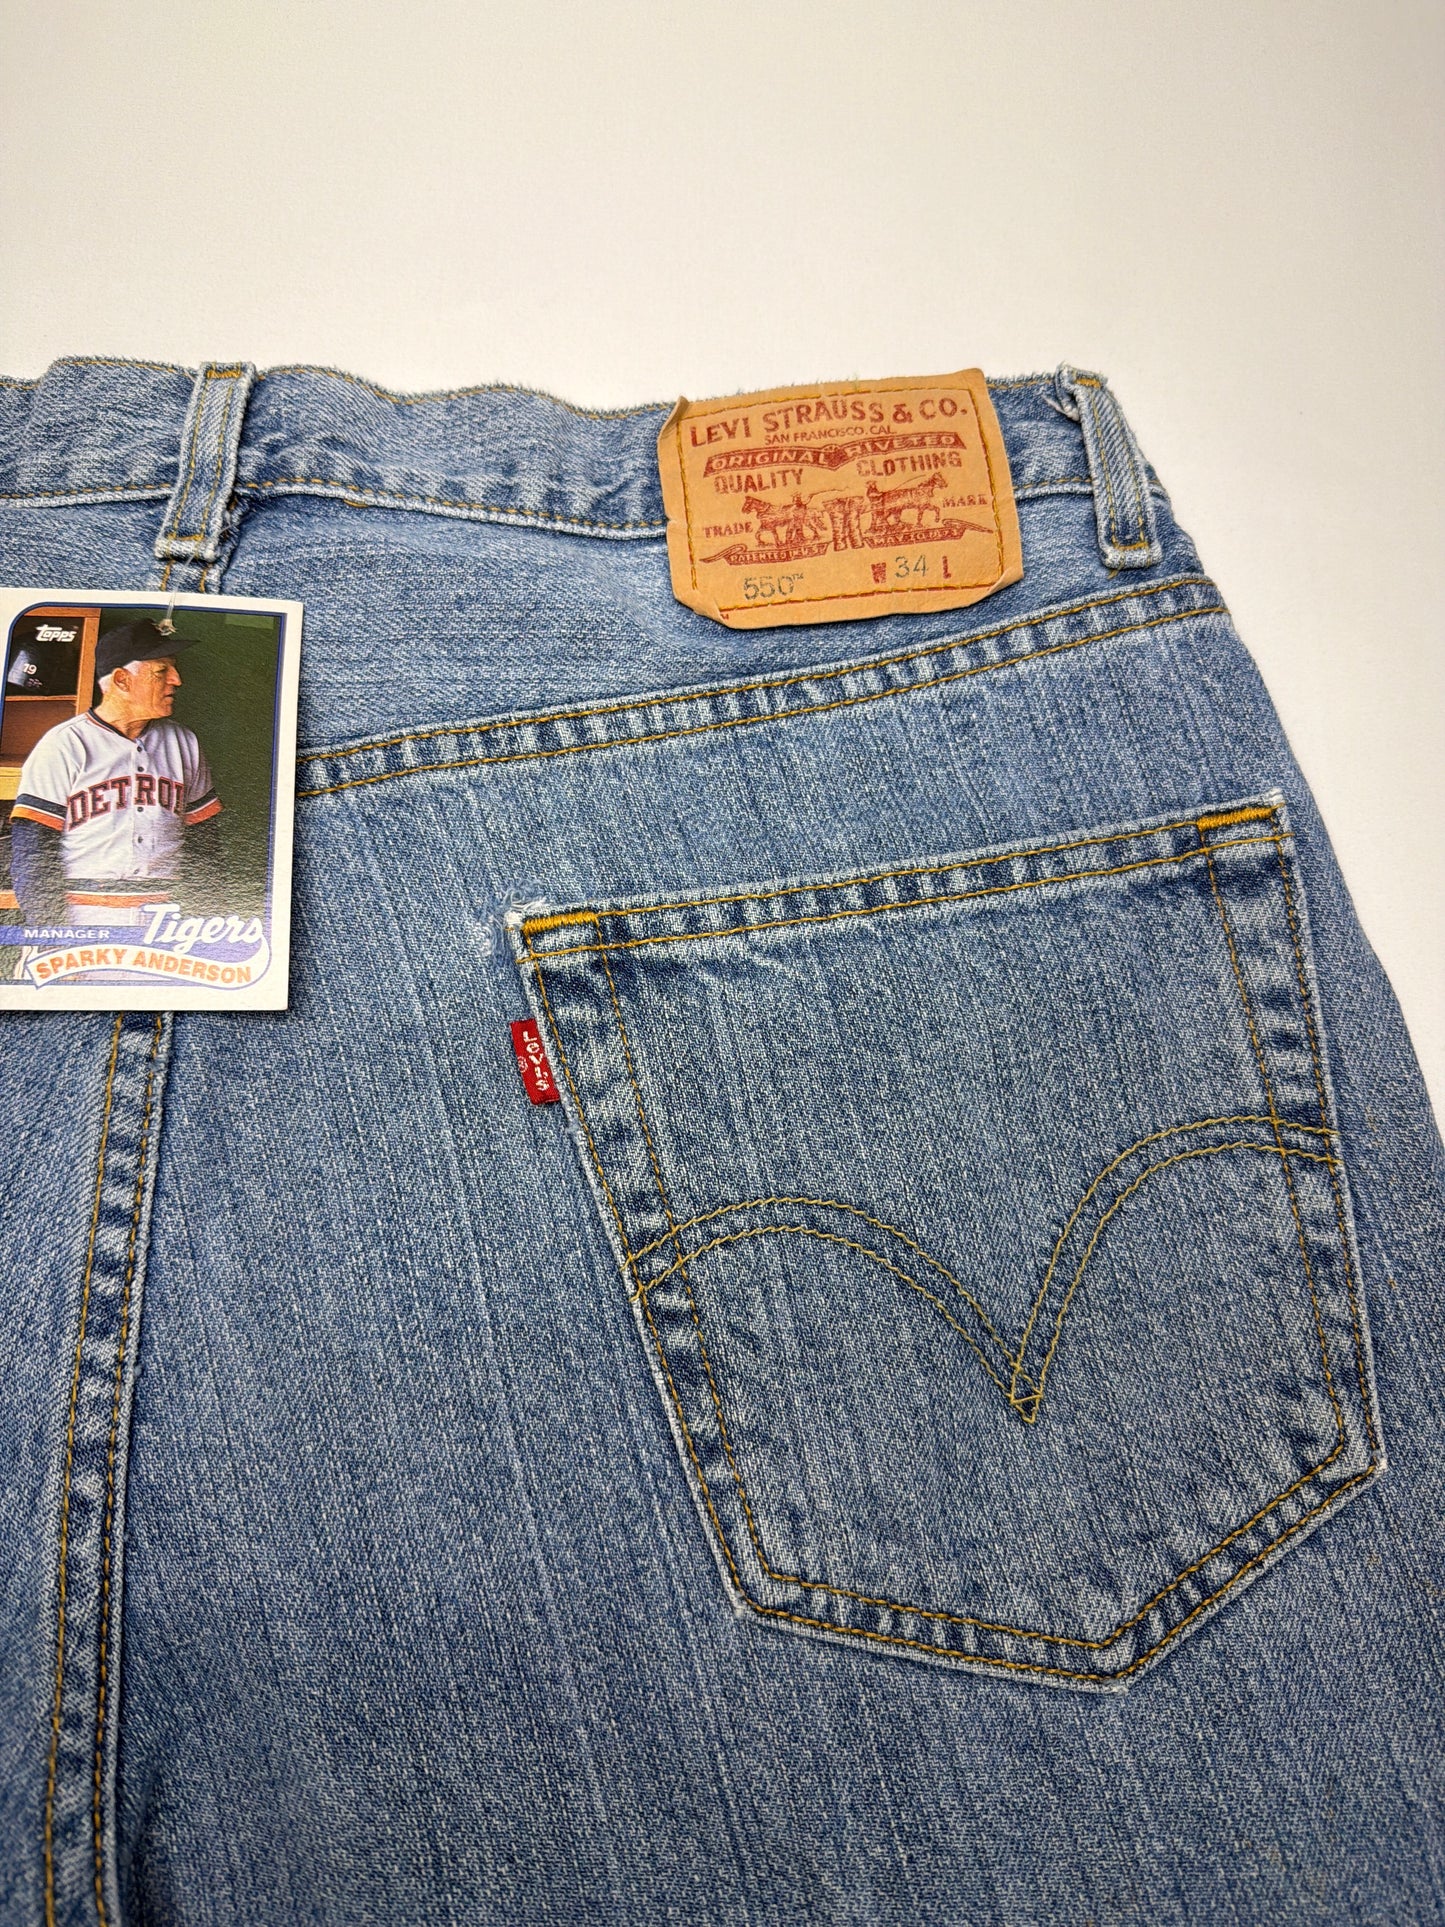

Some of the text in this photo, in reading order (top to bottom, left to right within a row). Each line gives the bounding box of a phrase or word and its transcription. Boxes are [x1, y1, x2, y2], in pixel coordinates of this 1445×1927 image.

[690, 397, 967, 448] LEVI STRAUSS & CO.
[711, 434, 956, 470] ORIGINAL RIVETED
[765, 433, 790, 446] SAN
[856, 451, 962, 477] CLOTHING
[714, 468, 804, 494] QUALITY
[942, 493, 988, 508] MARK
[703, 521, 753, 538] TRADE
[874, 533, 904, 545] MAY
[730, 551, 787, 563] PATENTED
[894, 554, 928, 579] 34
[23, 663, 37, 675] 19
[67, 773, 185, 831] DETROI
[24, 928, 110, 939] MANAGER
[142, 903, 263, 954] Tigers
[36, 948, 252, 984] SPARKY ANDERSON
